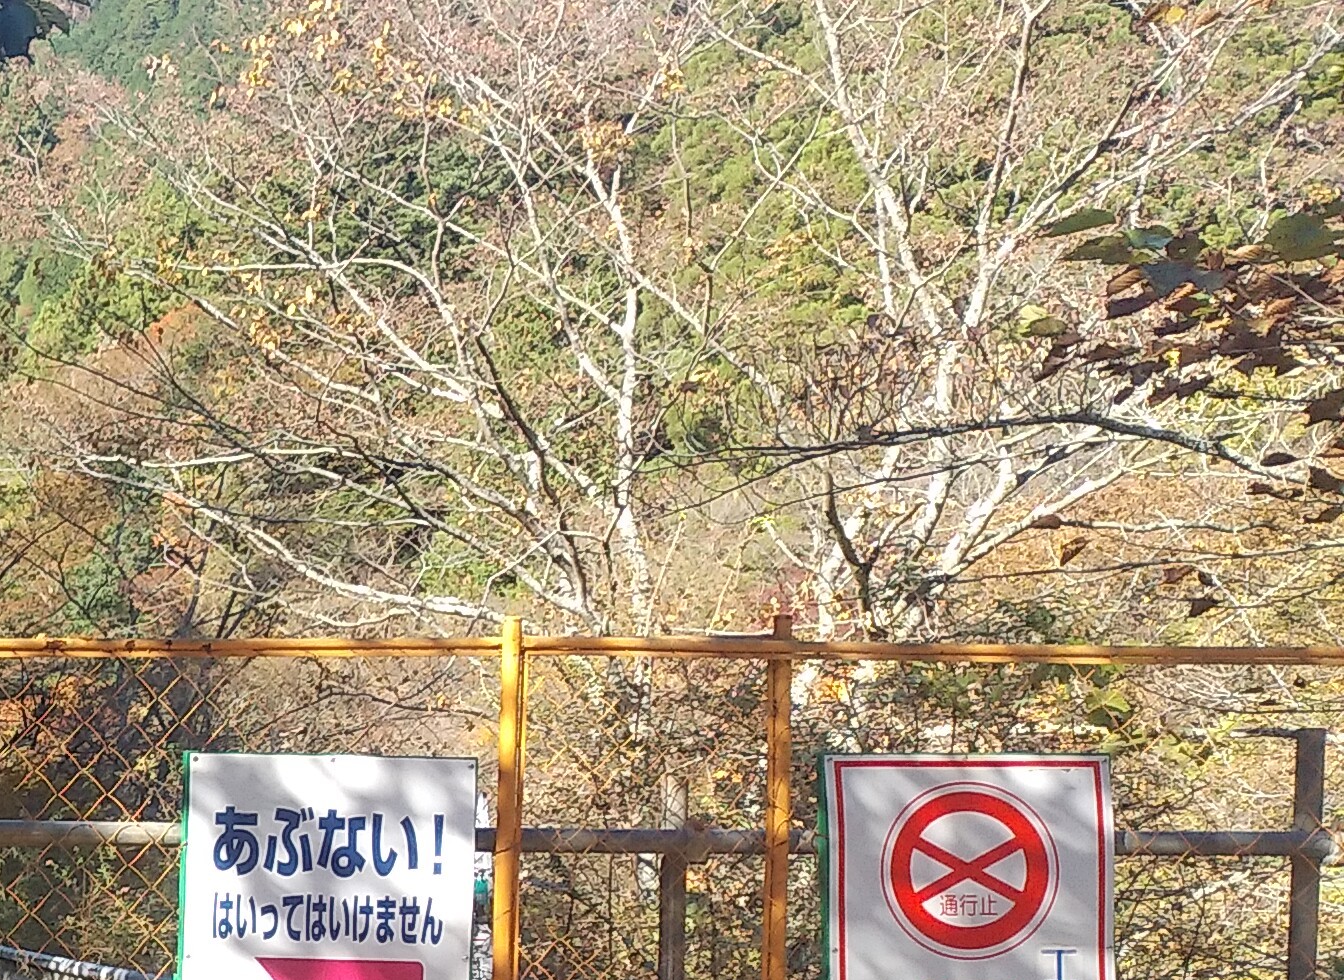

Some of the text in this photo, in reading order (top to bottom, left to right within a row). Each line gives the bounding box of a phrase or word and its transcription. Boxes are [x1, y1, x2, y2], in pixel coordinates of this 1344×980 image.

[212, 805, 446, 879] あぶない！
[212, 892, 444, 945] はいってはいけません
[938, 894, 999, 918] 通行止
